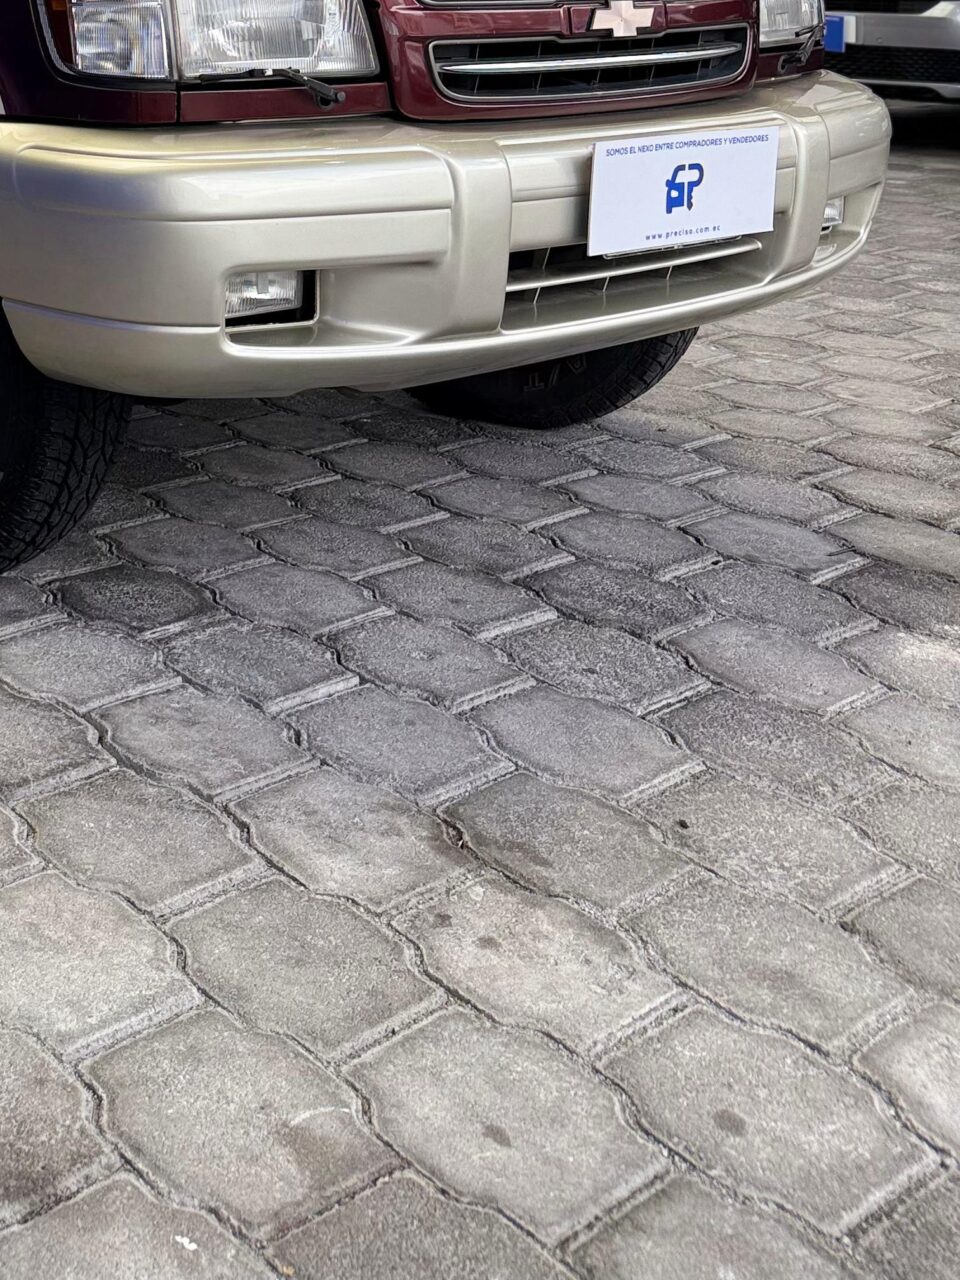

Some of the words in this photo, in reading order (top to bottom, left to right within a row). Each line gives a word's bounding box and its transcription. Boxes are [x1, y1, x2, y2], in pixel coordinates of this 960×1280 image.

[605, 148, 629, 157] SOMOS
[629, 147, 637, 155] EL
[638, 144, 654, 153] NEXO
[654, 142, 674, 152] ENTRE
[675, 138, 722, 150] COMPRADORES
[728, 134, 769, 145] VENDEDORES
